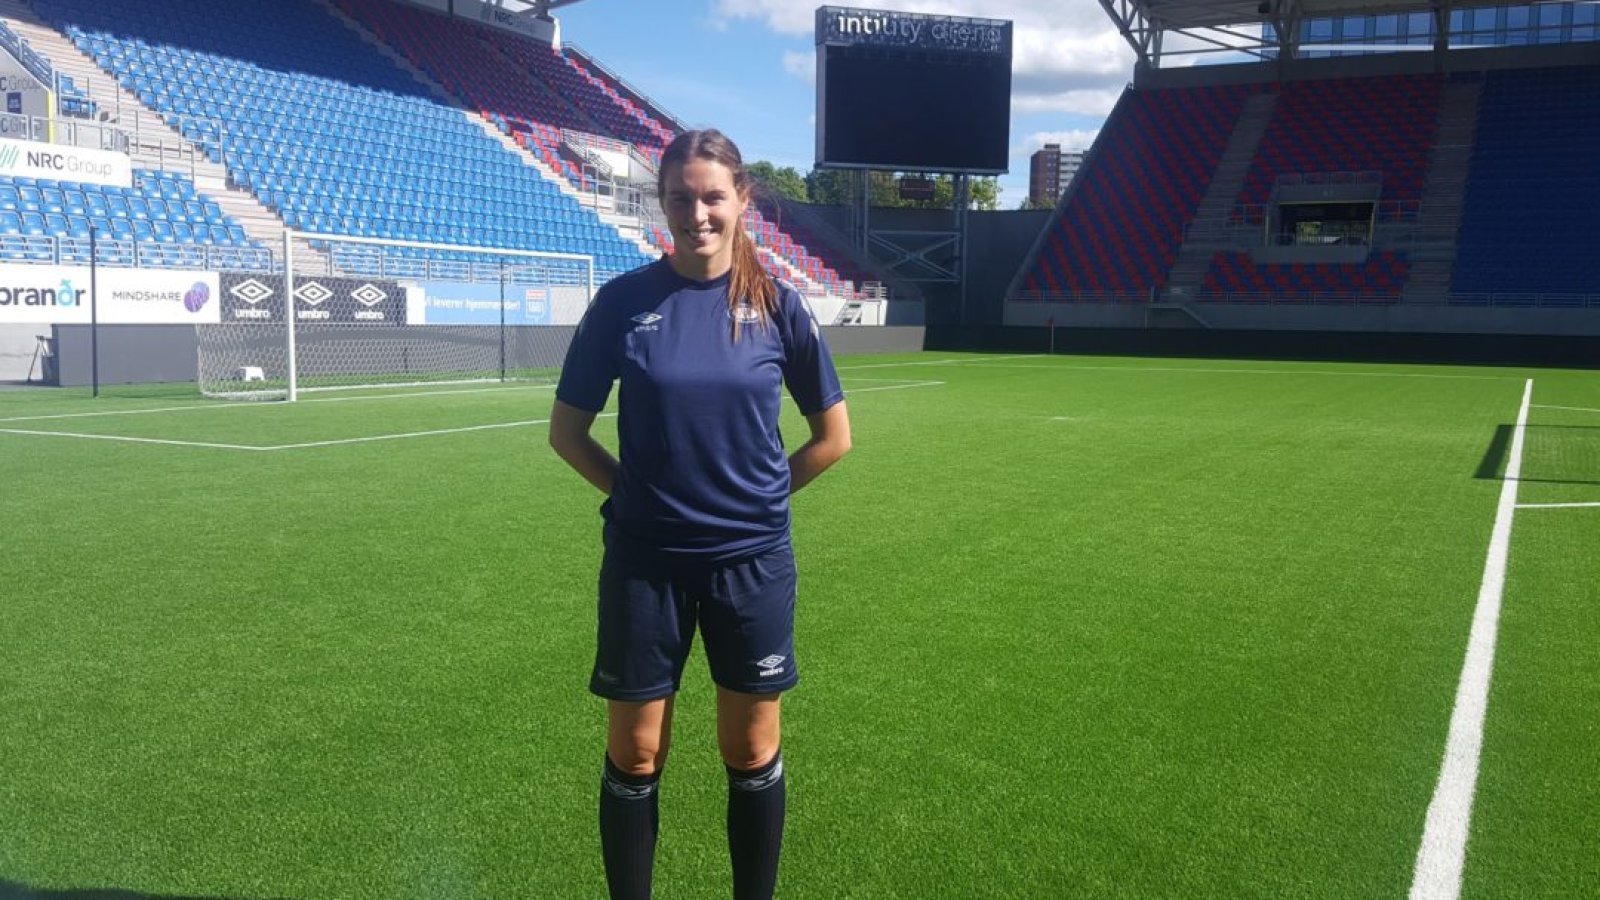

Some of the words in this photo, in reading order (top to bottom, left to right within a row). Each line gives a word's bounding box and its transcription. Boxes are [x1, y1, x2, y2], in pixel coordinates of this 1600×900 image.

[837, 9, 921, 43] intility
[27, 150, 65, 170] NRC
[67, 155, 112, 177] Group
[112, 290, 182, 301] MINDSHARE
[234, 306, 270, 318] umbro
[297, 307, 330, 319] umbro
[354, 308, 385, 319] umbro
